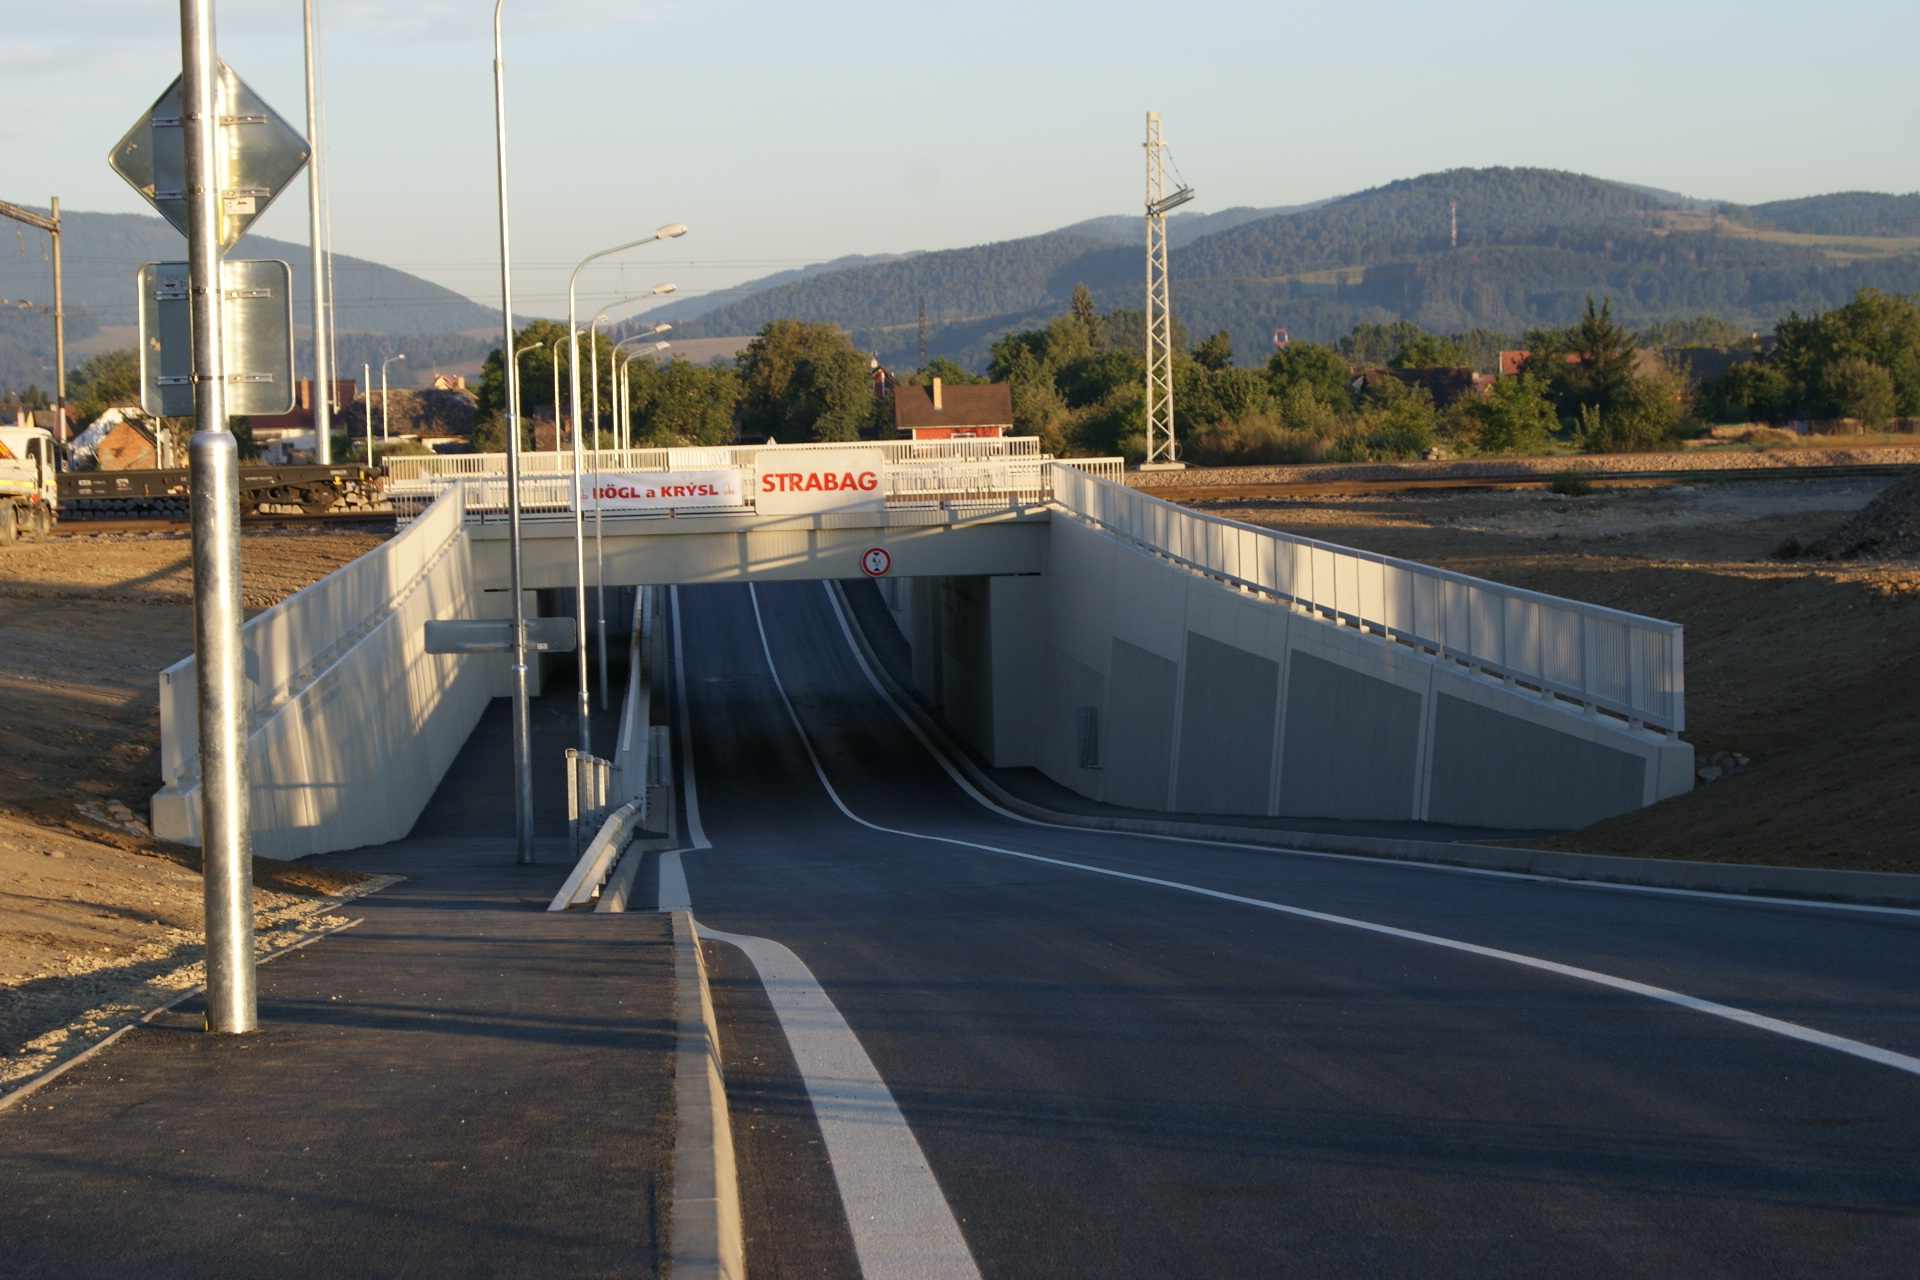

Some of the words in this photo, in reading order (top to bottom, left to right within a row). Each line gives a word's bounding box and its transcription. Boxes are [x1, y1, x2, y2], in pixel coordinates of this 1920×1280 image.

[646, 488, 655, 498] a
[661, 482, 718, 497] KRÝSL
[762, 471, 878, 493] STRABAG
